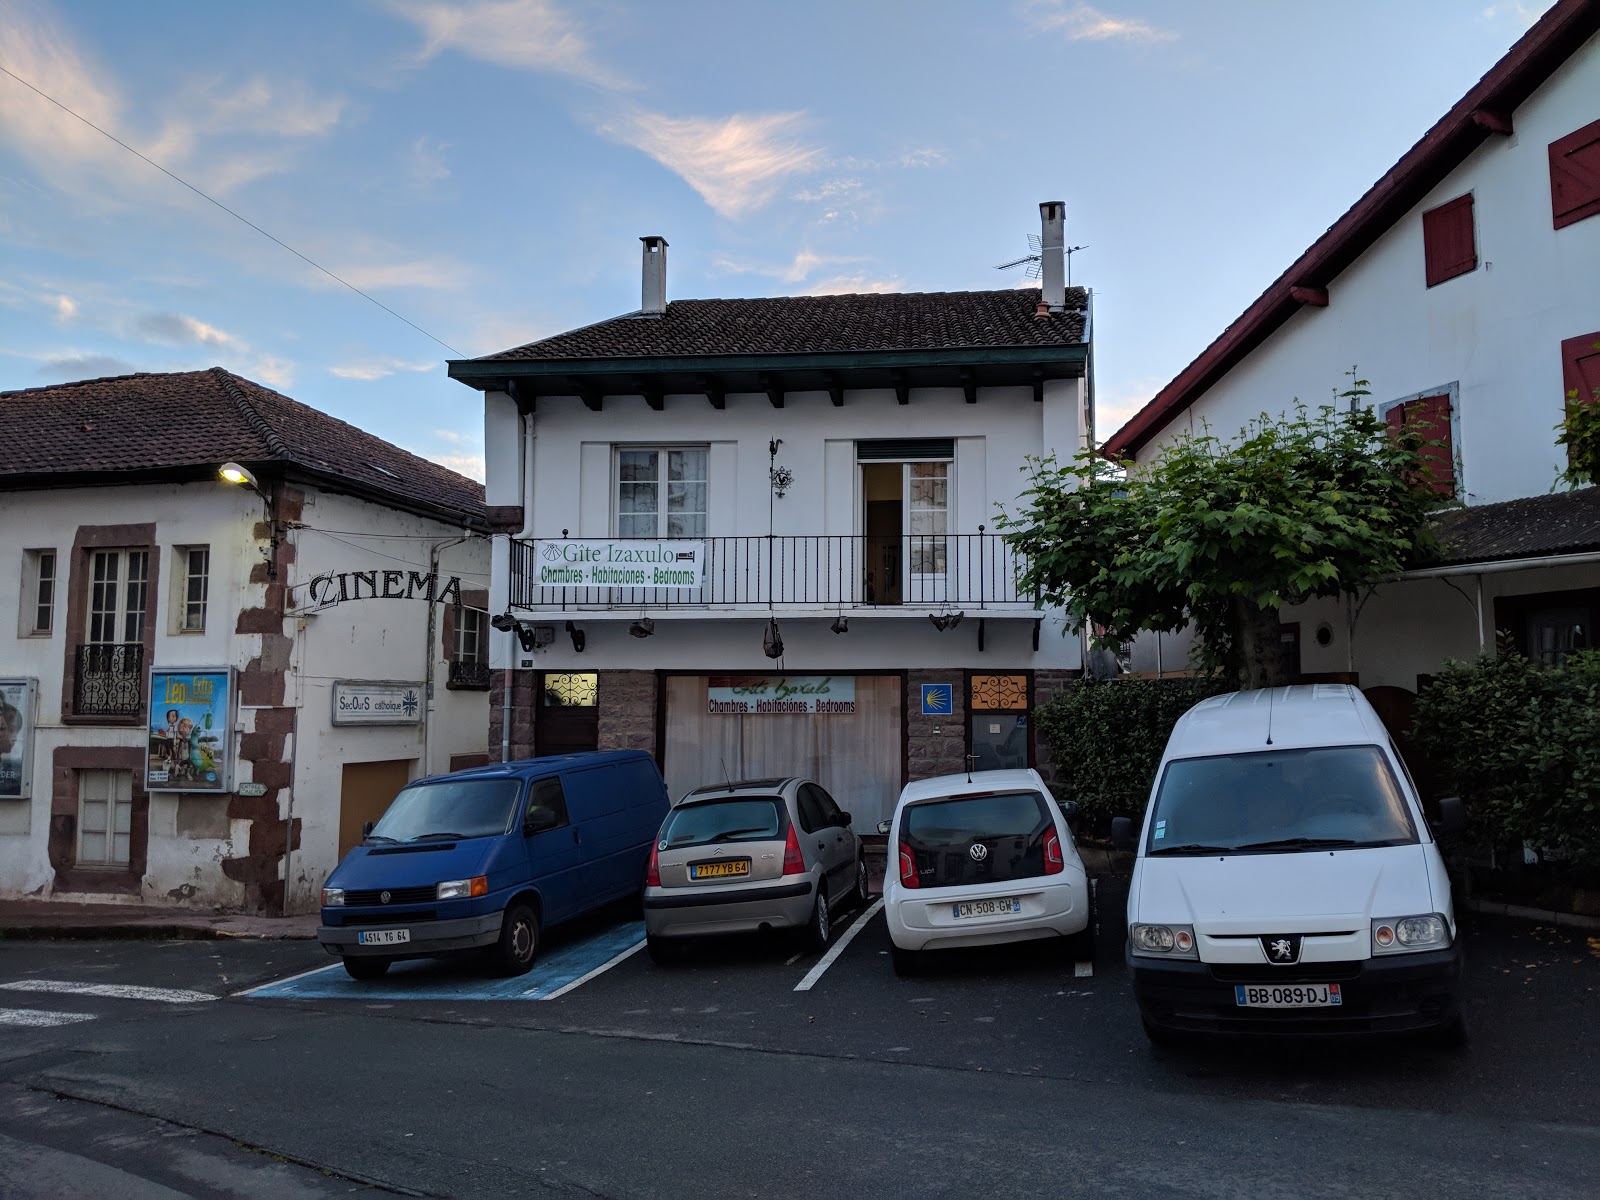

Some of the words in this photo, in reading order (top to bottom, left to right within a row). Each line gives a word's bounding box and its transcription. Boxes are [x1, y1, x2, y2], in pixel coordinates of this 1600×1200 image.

[563, 543, 601, 563] Gîte
[607, 543, 674, 563] Izaxulo
[541, 565, 583, 584] Chambres
[591, 566, 645, 585] Habitaciones
[653, 567, 695, 586] Bedrooms
[309, 570, 463, 608] CINEMA
[165, 675, 186, 705] Léo
[192, 675, 214, 695] Extra
[374, 700, 402, 712] catholique
[709, 699, 749, 713] Chambres
[756, 698, 808, 713] Habitaciónes
[816, 699, 855, 713] Bedrooms
[698, 865, 720, 876] 7177
[722, 863, 733, 874] YB
[735, 862, 746, 873] 64
[365, 932, 381, 943] 4514
[384, 932, 394, 942] YG
[397, 931, 406, 941] 64
[1248, 987, 1328, 1004] BB-089-DJ
